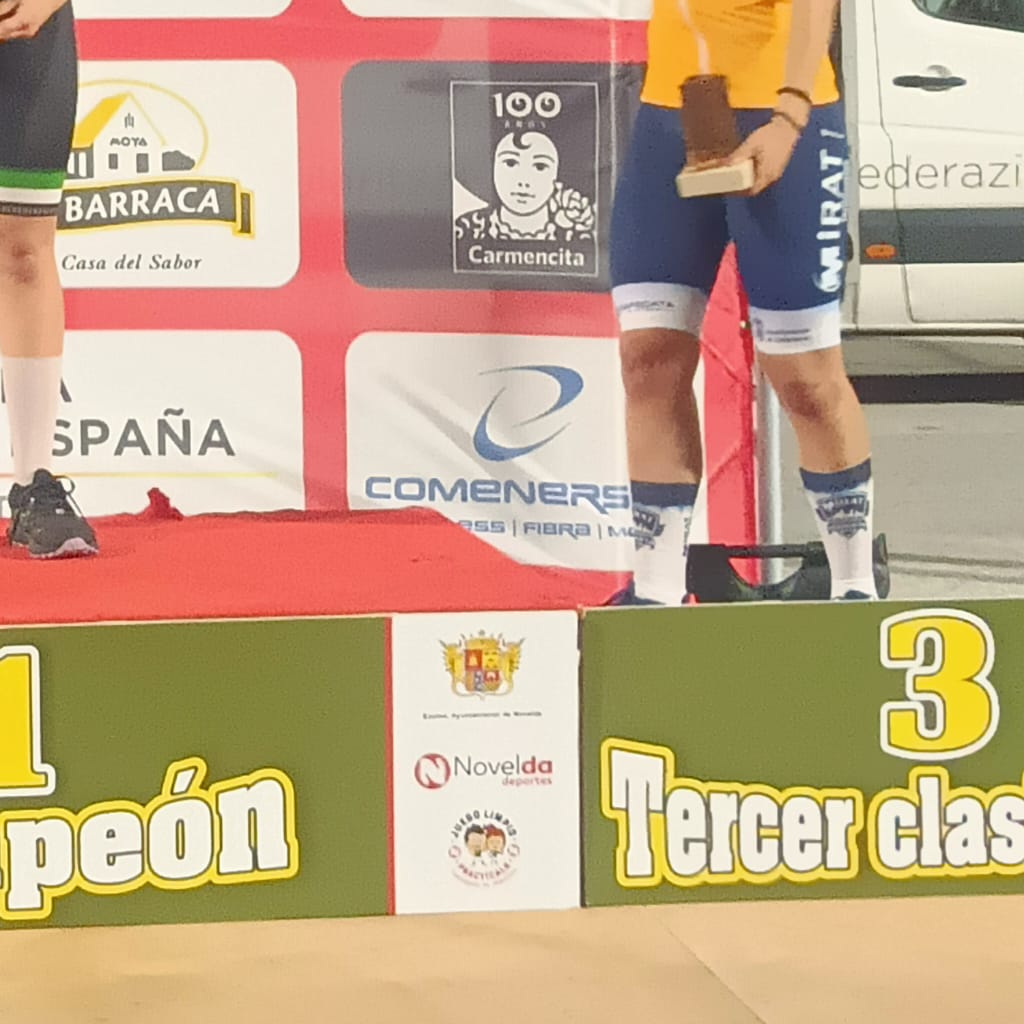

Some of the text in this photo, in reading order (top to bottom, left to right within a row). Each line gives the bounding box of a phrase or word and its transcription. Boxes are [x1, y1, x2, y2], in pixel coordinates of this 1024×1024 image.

[491, 91, 562, 118] 100
[109, 136, 148, 148] MOYA
[858, 153, 1022, 190] ederazi
[64, 186, 221, 223] BARRACA
[816, 148, 845, 293] MIRAT
[61, 253, 204, 271] Casa del Sabor
[467, 244, 586, 267] Carmencita
[38, 408, 236, 458] SPAÑA
[879, 608, 1000, 761] 3
[453, 754, 553, 777] Novelda
[502, 775, 553, 787] deportes
[600, 738, 1024, 888] Tercer clas
